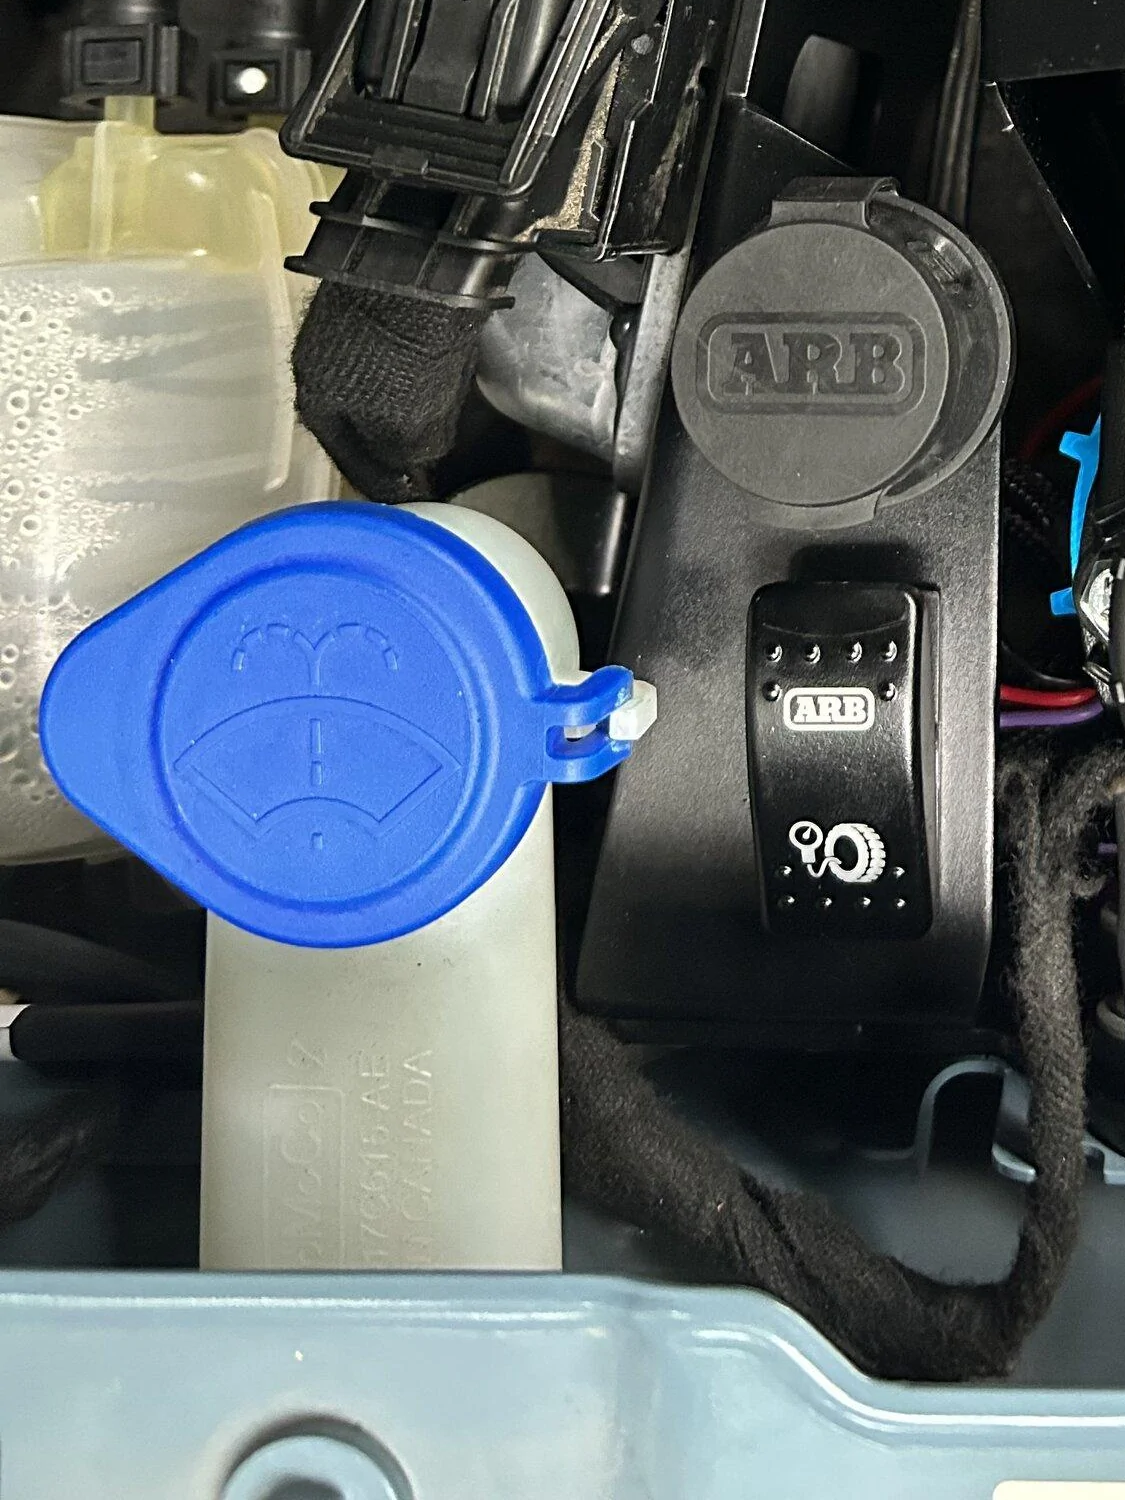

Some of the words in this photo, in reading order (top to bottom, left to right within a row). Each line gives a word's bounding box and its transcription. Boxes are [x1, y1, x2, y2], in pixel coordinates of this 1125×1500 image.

[722, 333, 906, 396] ARB
[794, 695, 867, 724] ARB
[402, 1050, 433, 1222] CANADA
